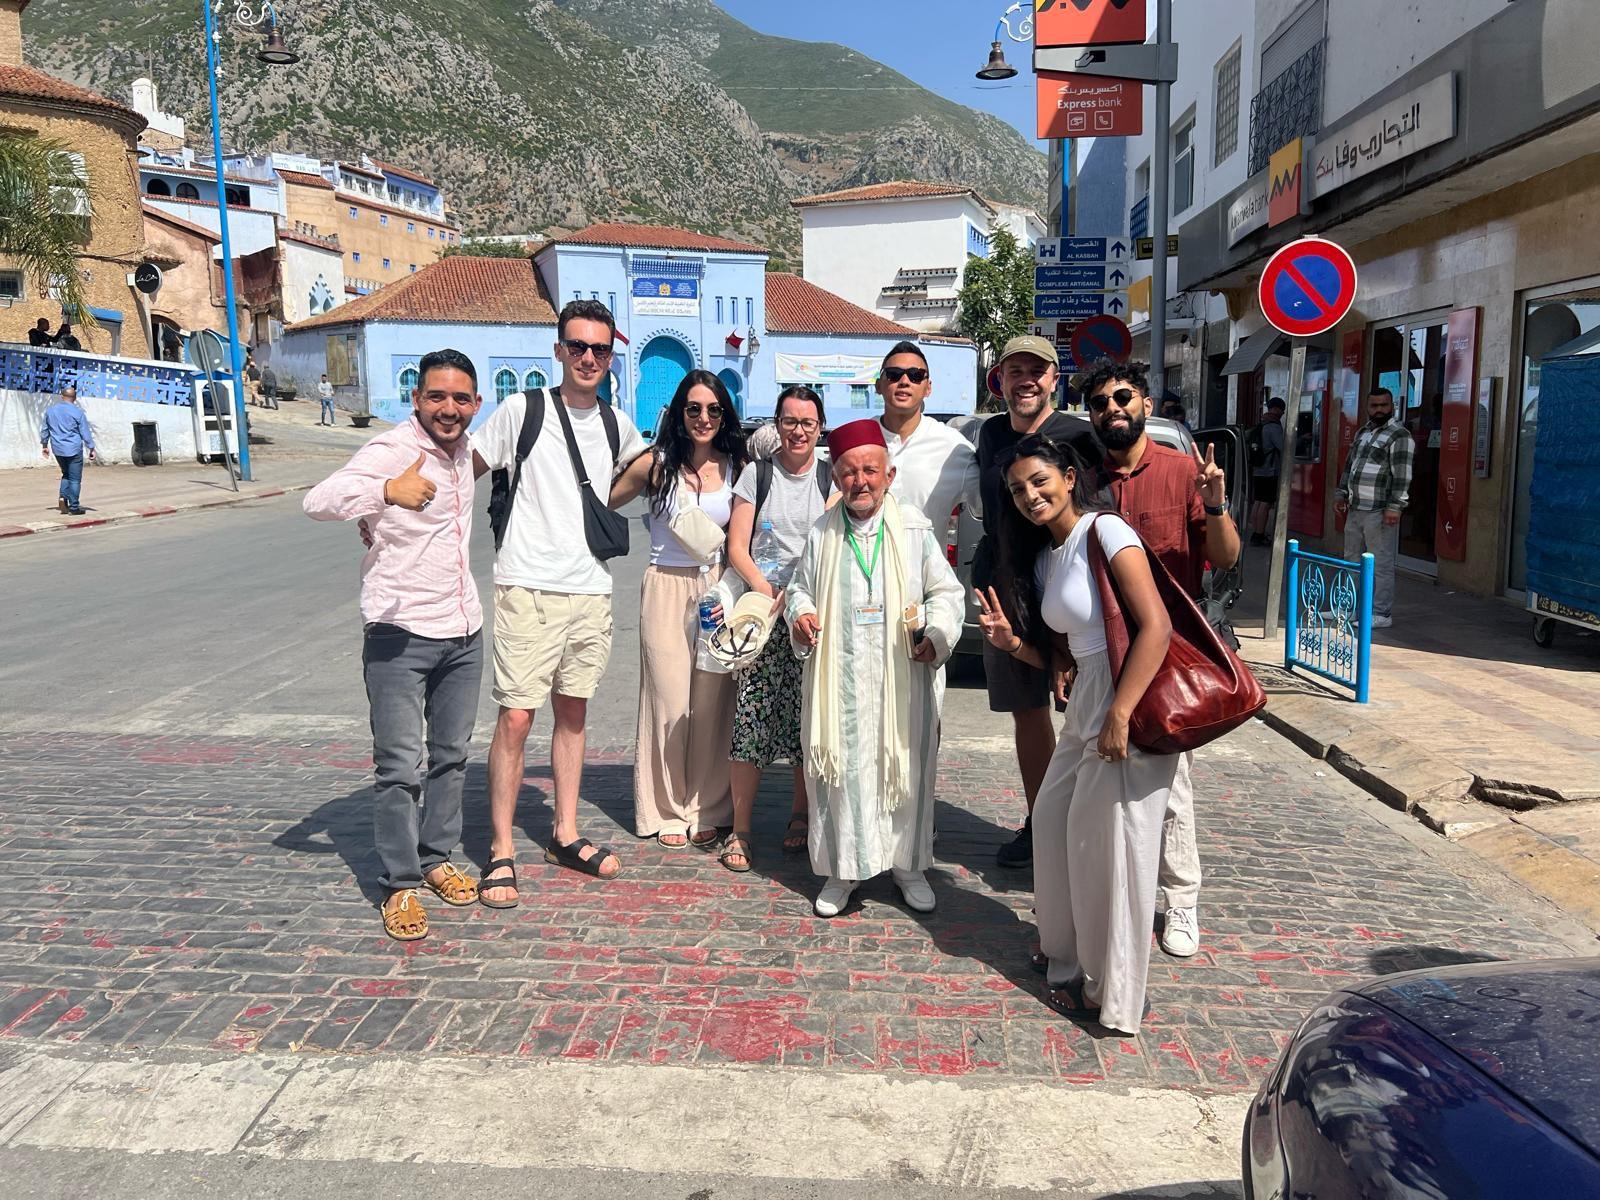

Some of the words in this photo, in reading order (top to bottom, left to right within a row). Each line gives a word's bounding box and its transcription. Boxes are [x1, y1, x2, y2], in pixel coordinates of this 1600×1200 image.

[1057, 99, 1097, 111] Express
[1098, 97, 1122, 108] bank
[1358, 102, 1420, 160] التجاري
[1069, 240, 1099, 249] القصبة
[1041, 296, 1061, 306] الحمام
